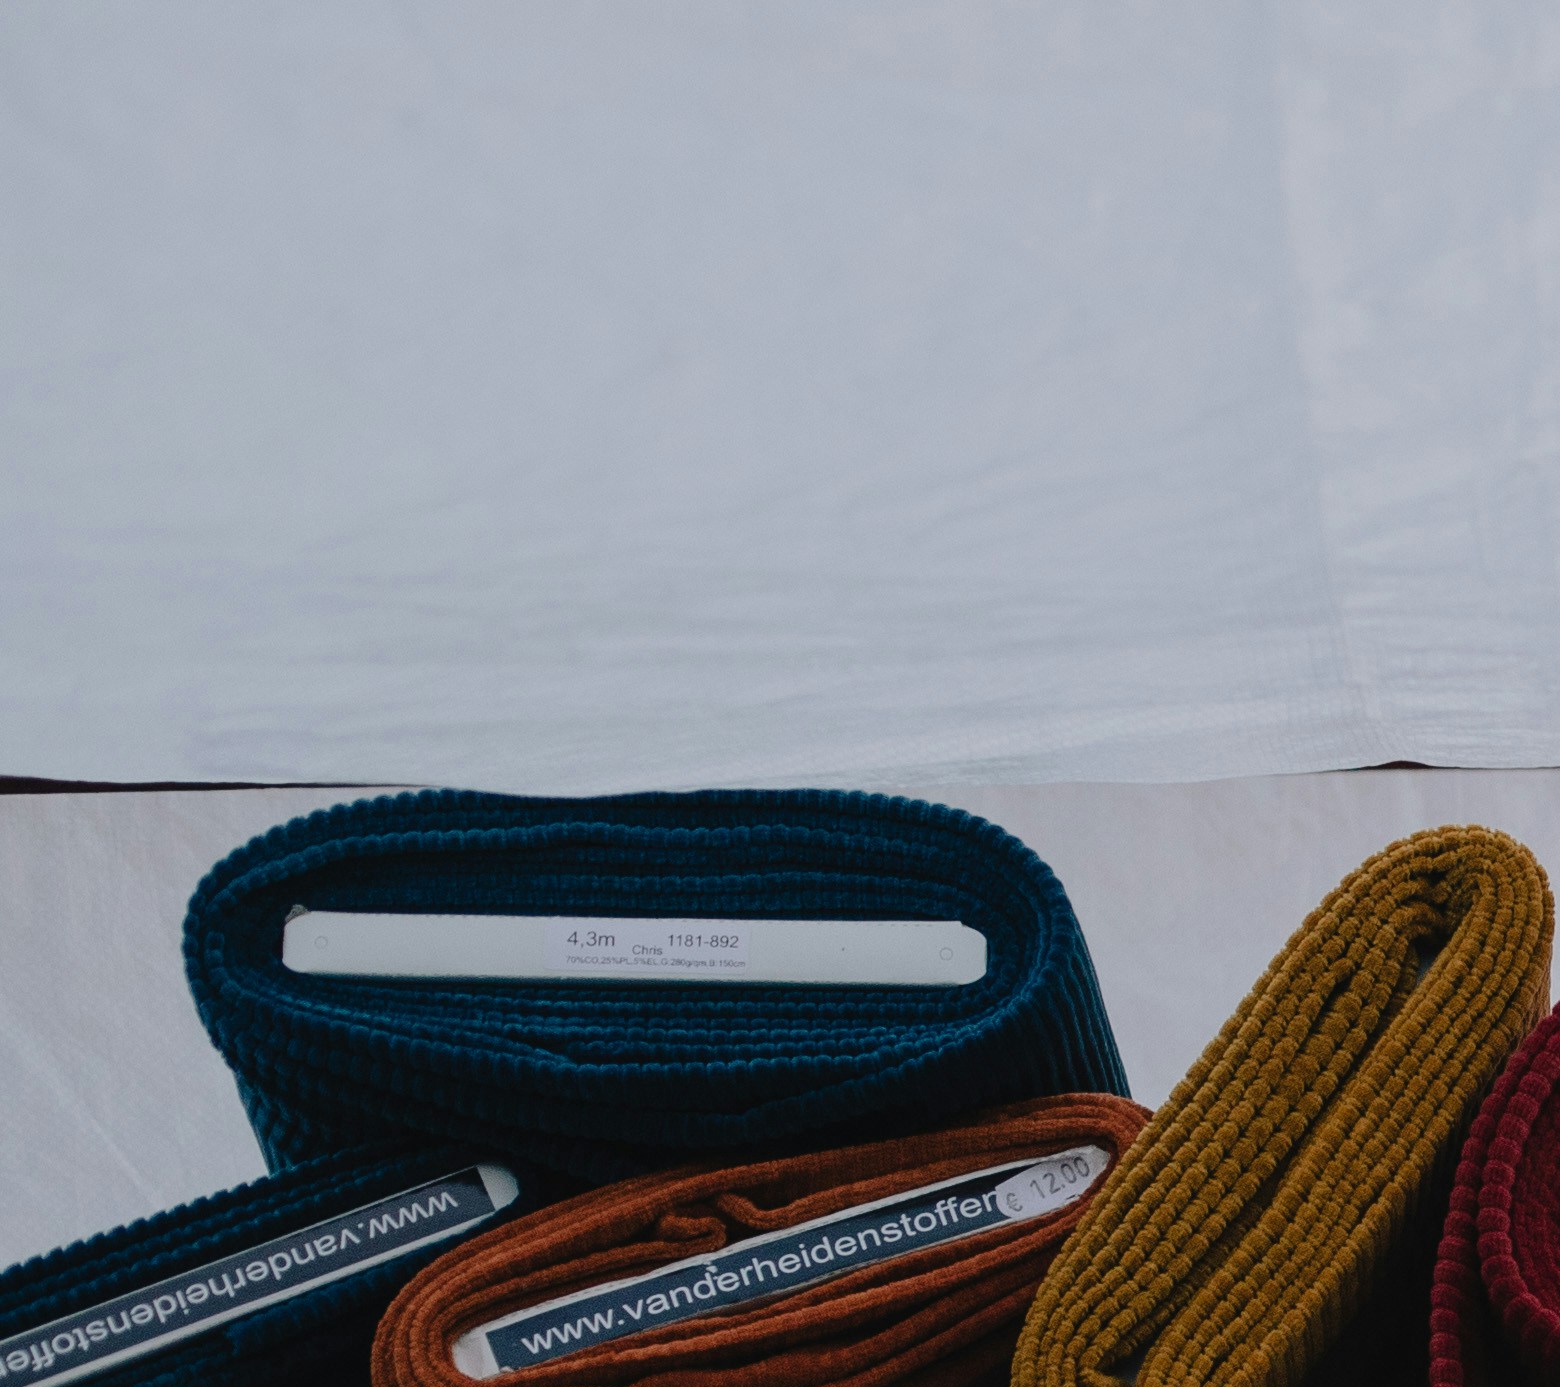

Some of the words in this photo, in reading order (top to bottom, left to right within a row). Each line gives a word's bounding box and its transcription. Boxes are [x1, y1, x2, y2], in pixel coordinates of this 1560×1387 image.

[566, 931, 616, 949] 4,3m
[667, 933, 740, 949] 1181-892
[631, 944, 663, 956] Chris
[1029, 1155, 1091, 1199] 12.00
